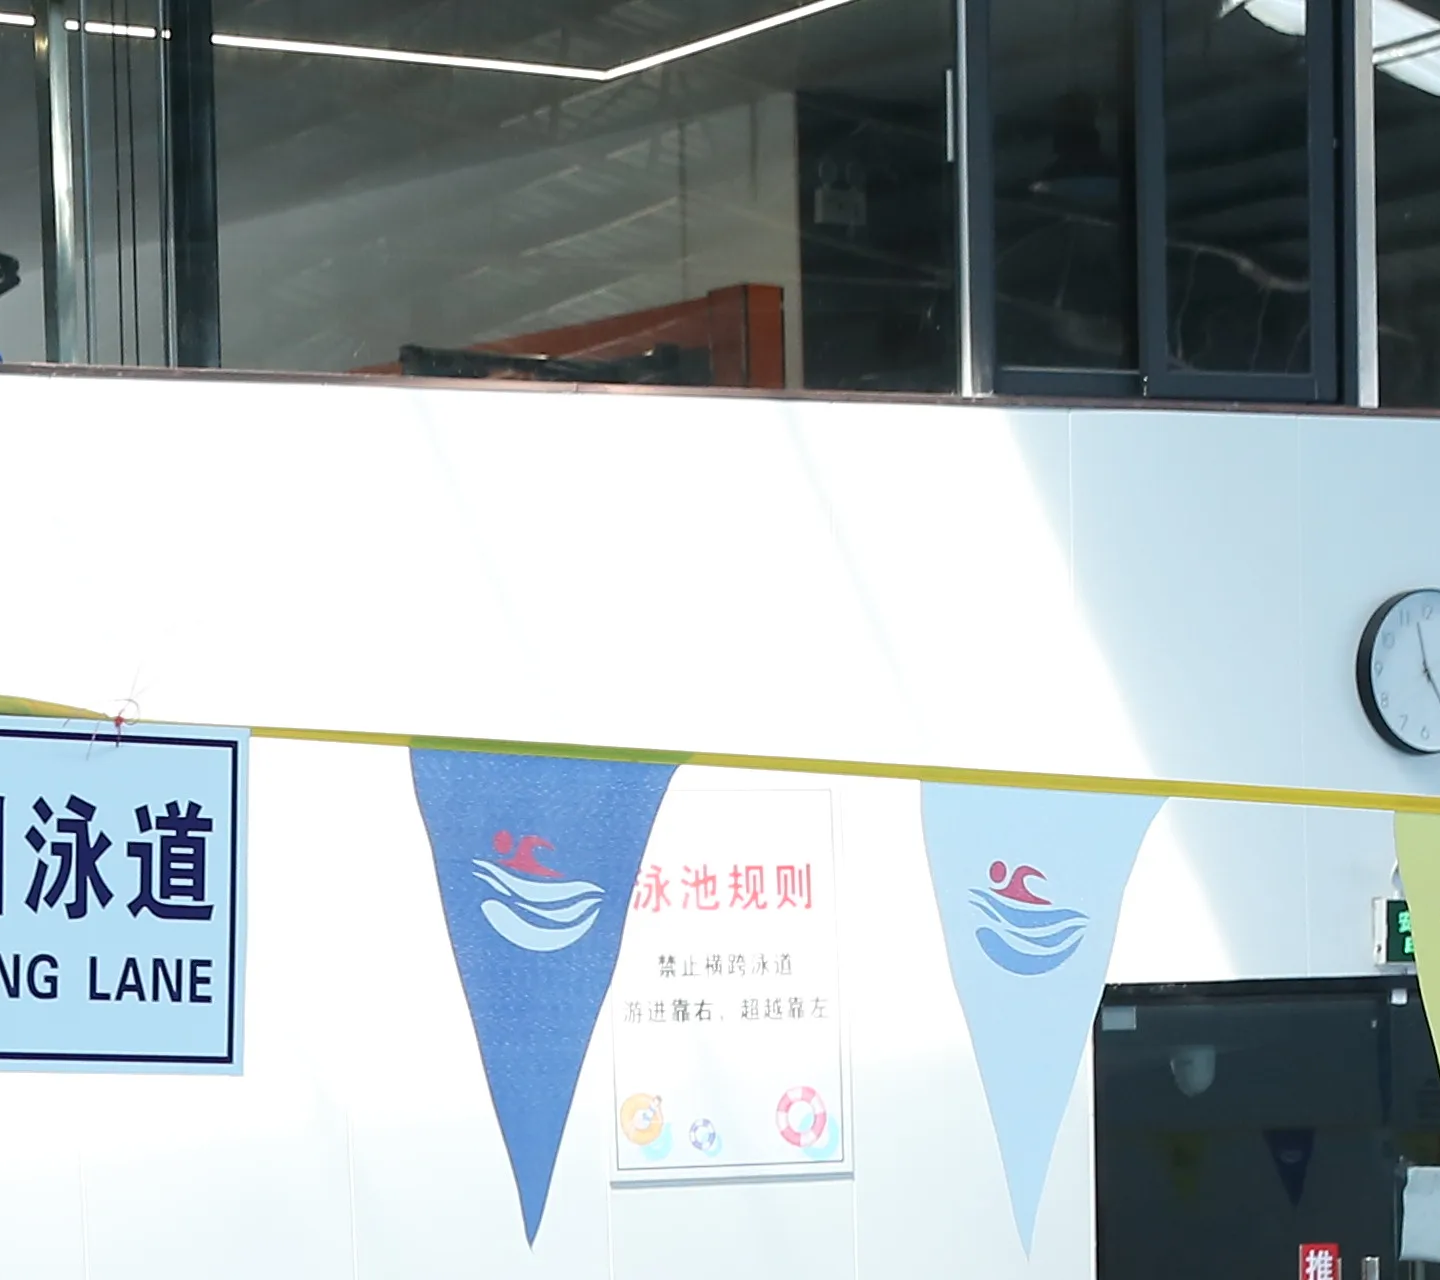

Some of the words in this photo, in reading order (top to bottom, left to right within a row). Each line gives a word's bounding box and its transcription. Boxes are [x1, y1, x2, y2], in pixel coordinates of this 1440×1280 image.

[633, 863, 813, 913] 泳池规则
[88, 956, 213, 1004] LANE
[658, 953, 793, 978] 禁止横跨泳道
